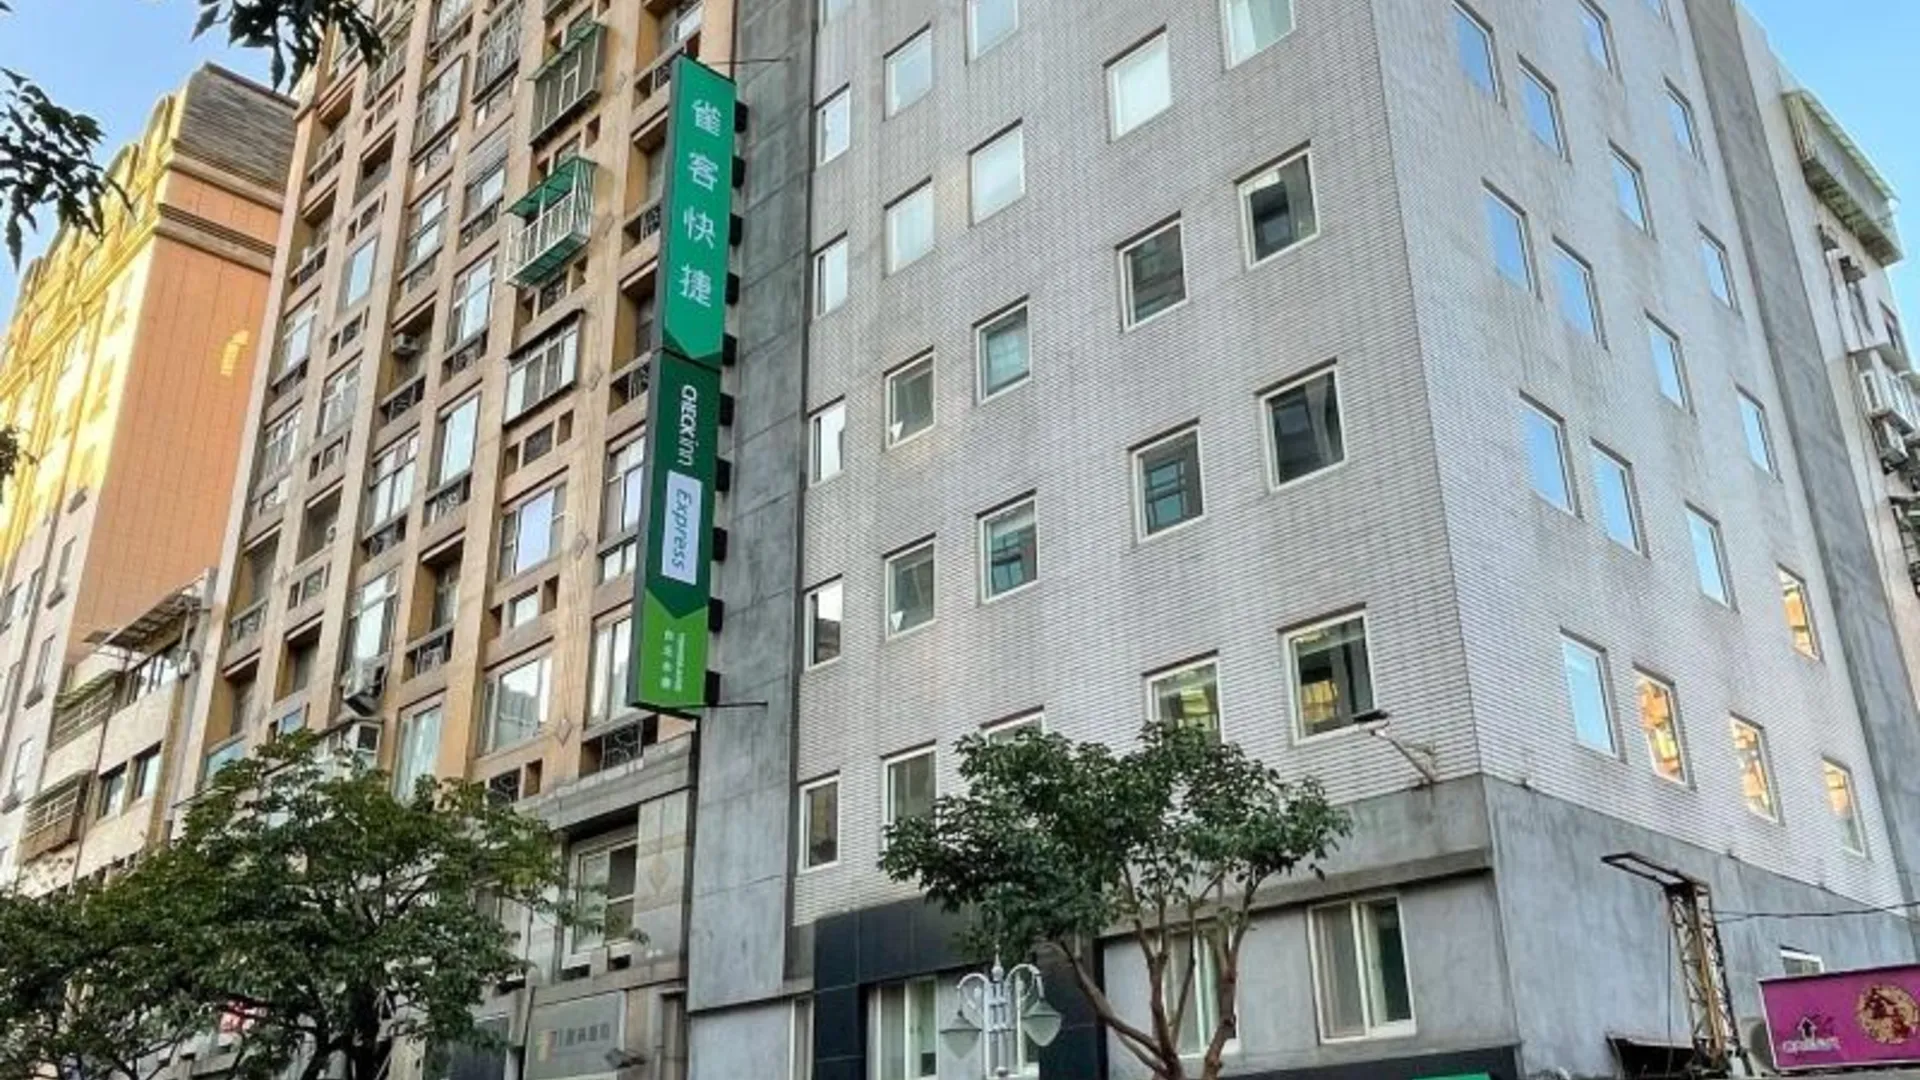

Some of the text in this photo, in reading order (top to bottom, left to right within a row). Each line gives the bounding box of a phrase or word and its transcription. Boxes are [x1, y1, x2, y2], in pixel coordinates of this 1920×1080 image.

[679, 98, 722, 308] 雀客快捷
[671, 487, 693, 572] Express
